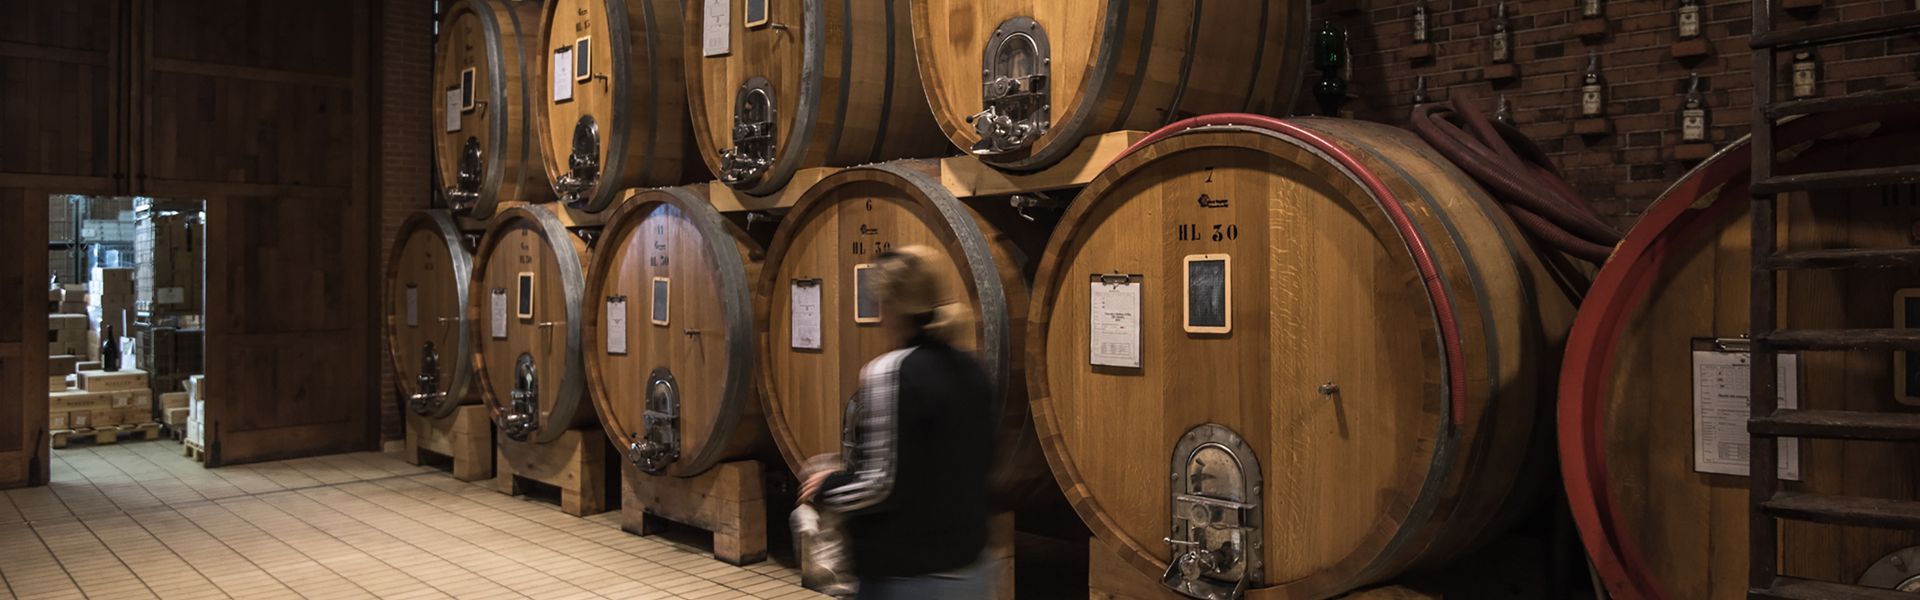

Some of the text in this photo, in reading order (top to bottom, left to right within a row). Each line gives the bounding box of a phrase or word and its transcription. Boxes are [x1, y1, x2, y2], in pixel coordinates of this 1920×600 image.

[1205, 166, 1215, 183] 7
[866, 199, 872, 211] 6
[1179, 224, 1238, 242] HL 30
[852, 241, 866, 255] HL
